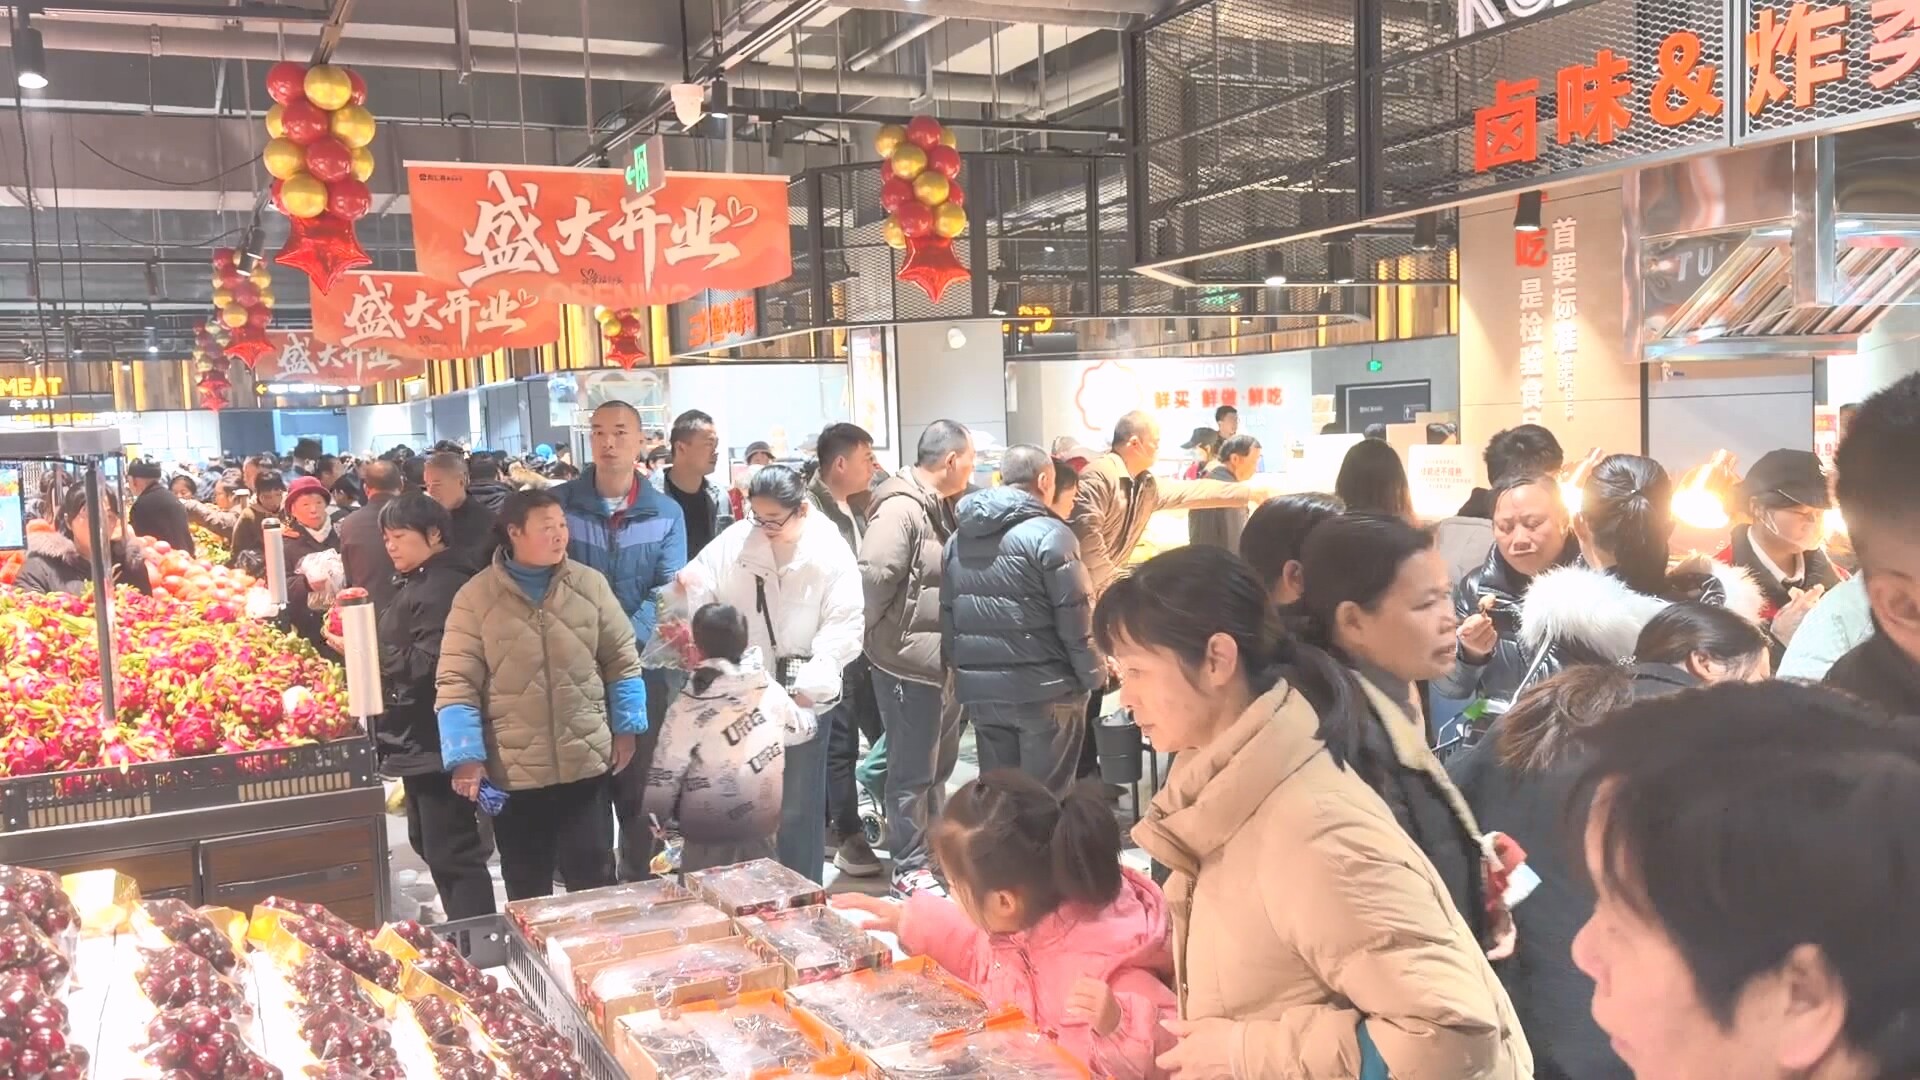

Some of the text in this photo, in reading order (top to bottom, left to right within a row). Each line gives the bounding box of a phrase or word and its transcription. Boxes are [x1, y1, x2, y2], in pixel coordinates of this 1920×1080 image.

[458, 170, 741, 294] 盛大开业
[341, 274, 526, 350] 盛大开业
[1552, 216, 1577, 354] 首要标准
[0, 377, 62, 396] MEAT
